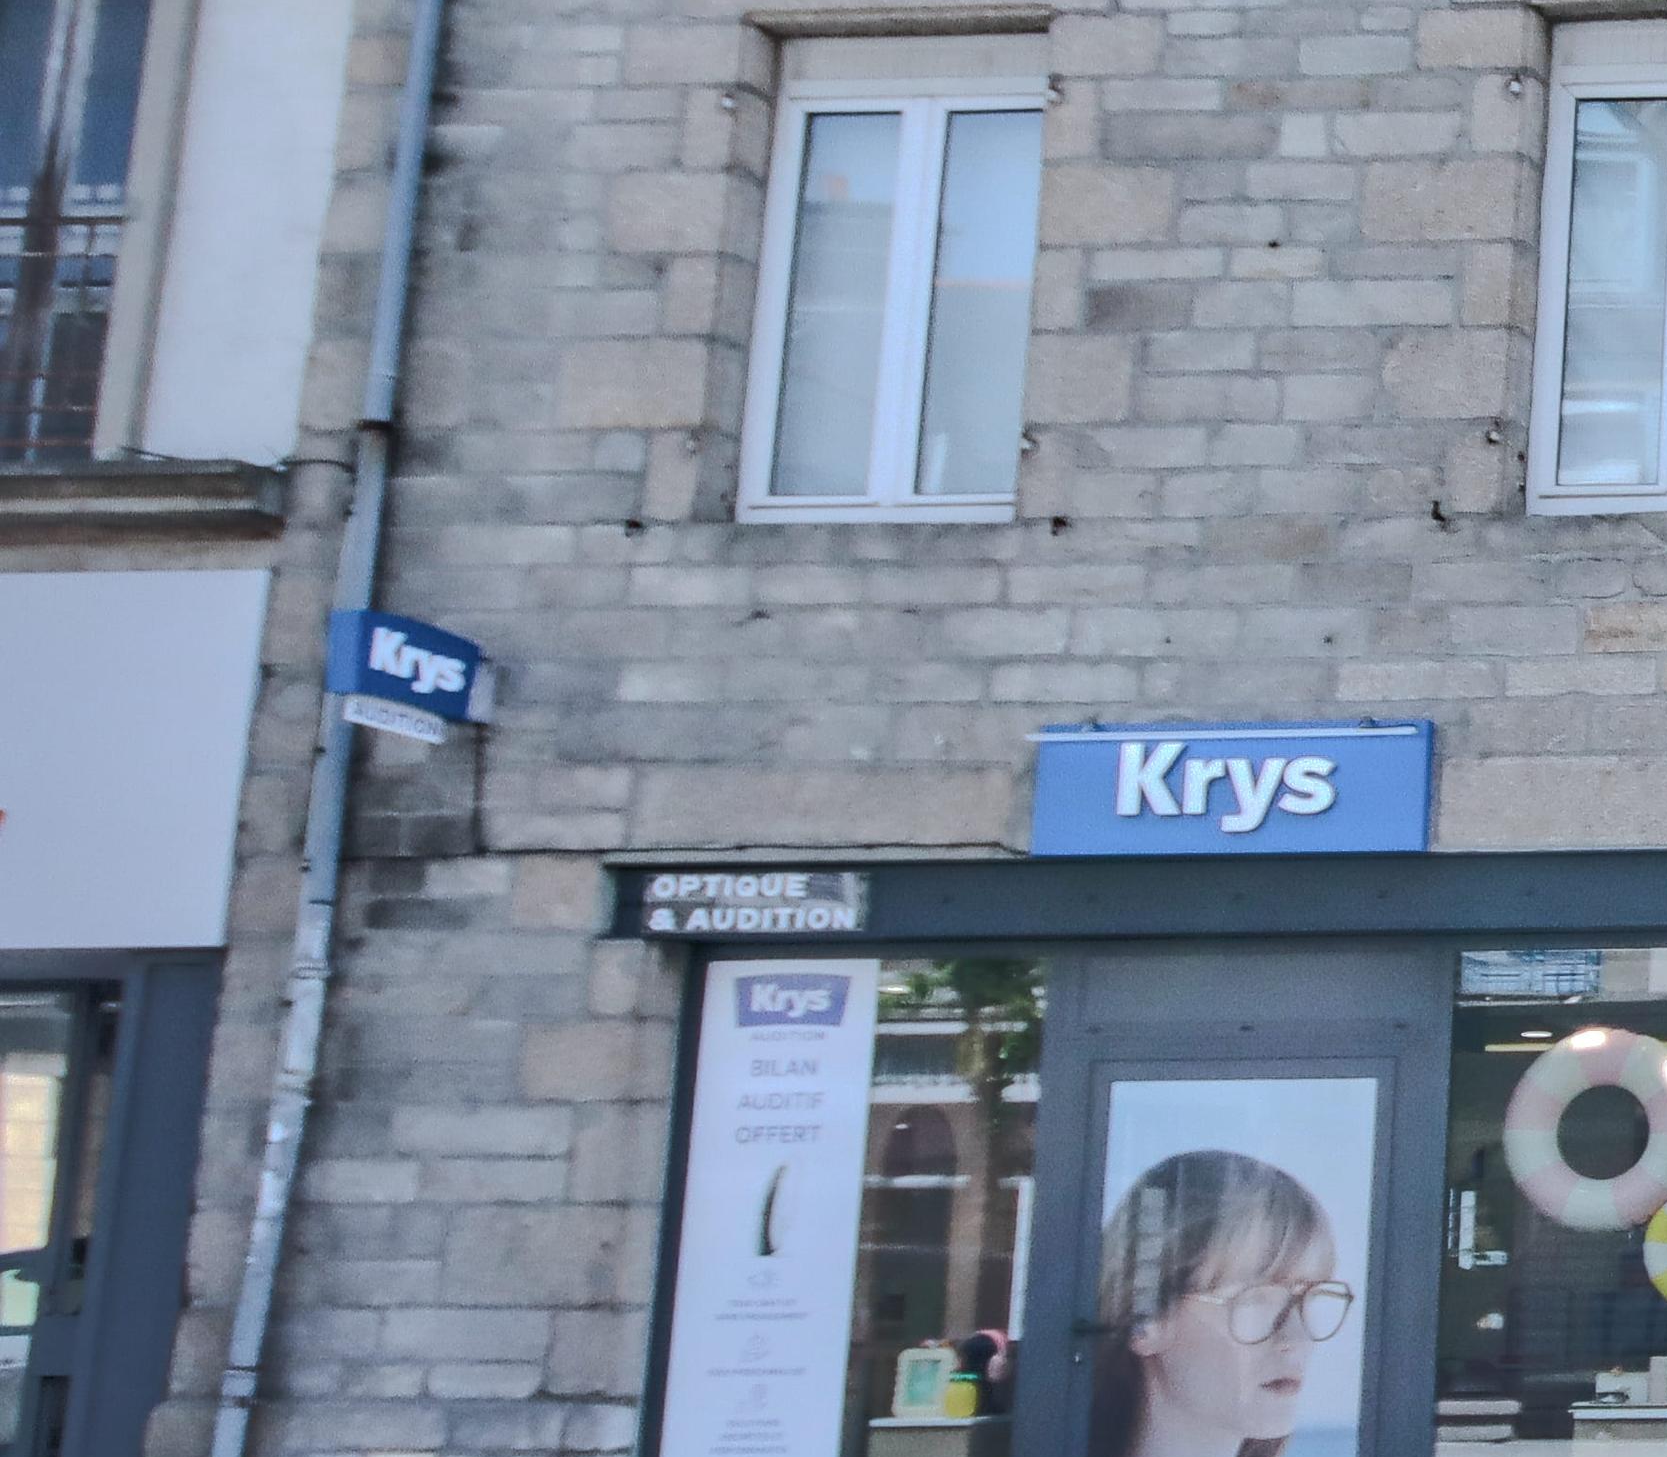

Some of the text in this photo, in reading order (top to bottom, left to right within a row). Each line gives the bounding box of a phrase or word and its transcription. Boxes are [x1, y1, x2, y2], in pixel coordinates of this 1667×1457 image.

[368, 626, 467, 694] Krys
[1116, 742, 1339, 834] Krys
[651, 874, 810, 898] OPTIQUE
[649, 907, 857, 931] & AUDITION
[749, 983, 832, 1018] Krys
[750, 1059, 819, 1078] BILAN
[736, 1091, 825, 1111] AUDITIF
[734, 1124, 823, 1144] OFFERT
